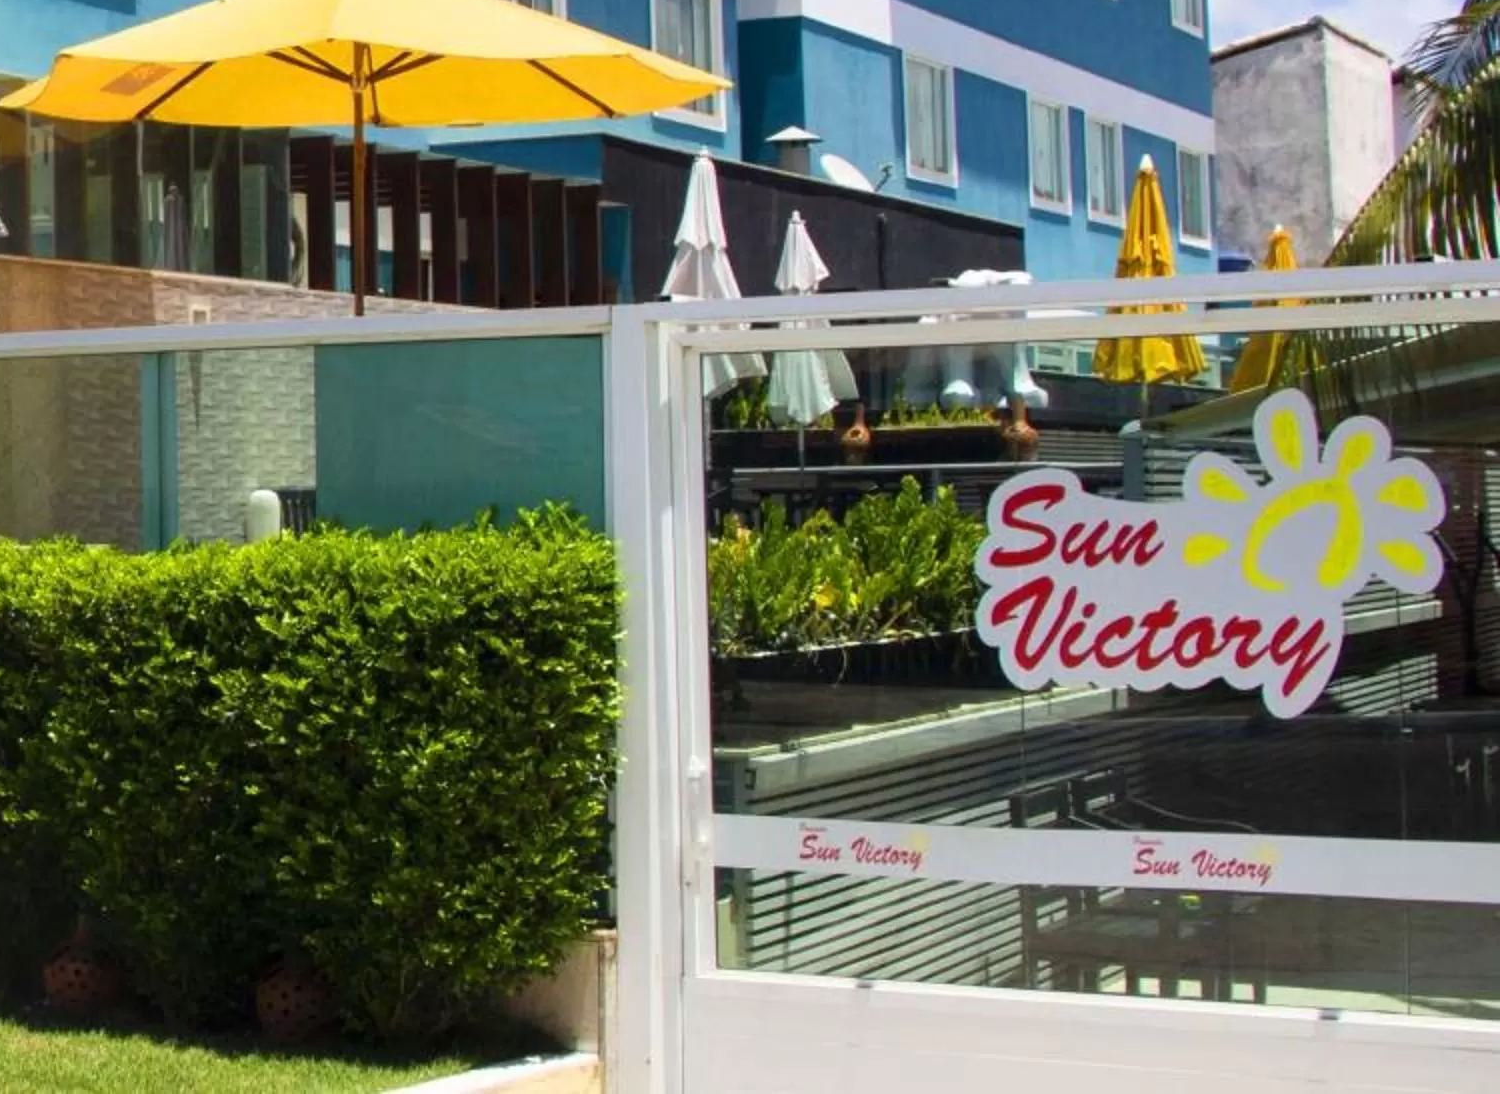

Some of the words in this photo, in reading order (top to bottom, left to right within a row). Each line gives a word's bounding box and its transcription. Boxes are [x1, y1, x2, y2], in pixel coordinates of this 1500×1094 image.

[990, 483, 1165, 568] Sun
[991, 575, 1331, 698] Victory
[799, 834, 841, 862] Sun
[850, 836, 922, 871] Victory
[1133, 847, 1181, 875] Sun
[1191, 849, 1273, 887] Victory
